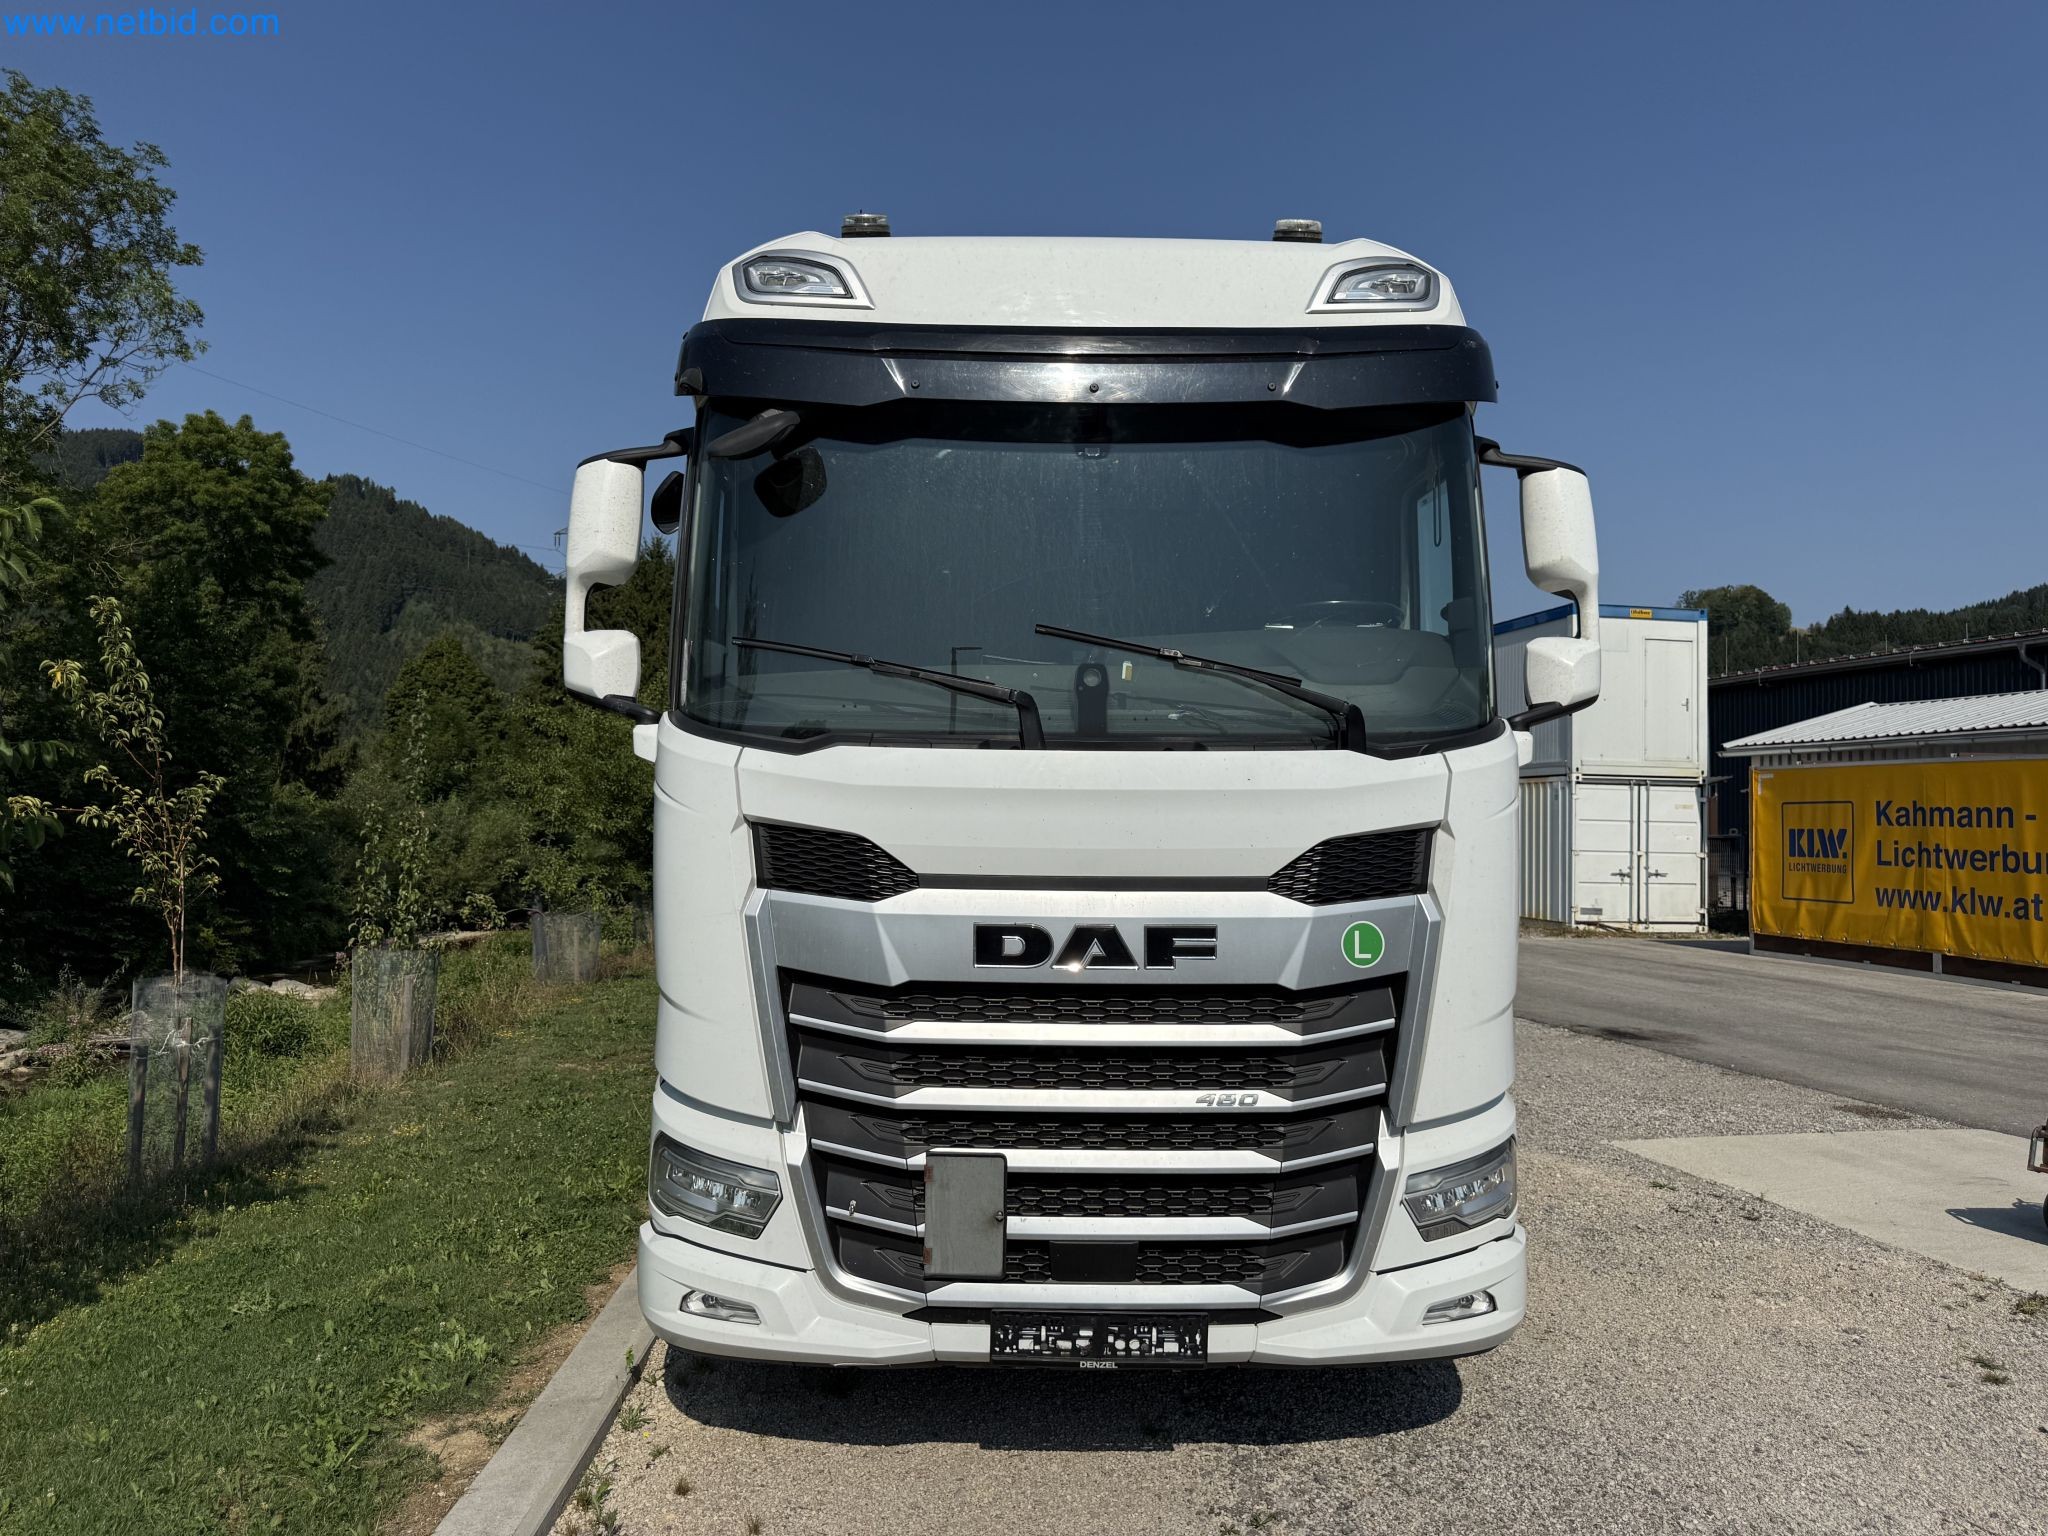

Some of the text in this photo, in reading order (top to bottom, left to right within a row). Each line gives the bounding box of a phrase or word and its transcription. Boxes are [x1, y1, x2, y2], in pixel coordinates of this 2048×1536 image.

[1875, 800, 2014, 828] Kahmann
[1788, 862, 1847, 874] LICHTWERBUNG
[1876, 839, 2048, 875] Lichtwerbu
[1875, 885, 2043, 921] www.klw.at
[973, 922, 1218, 970] DAF
[1354, 930, 1372, 959] L
[1195, 1093, 1259, 1107] 480
[1079, 1360, 1118, 1369] DENZEL
